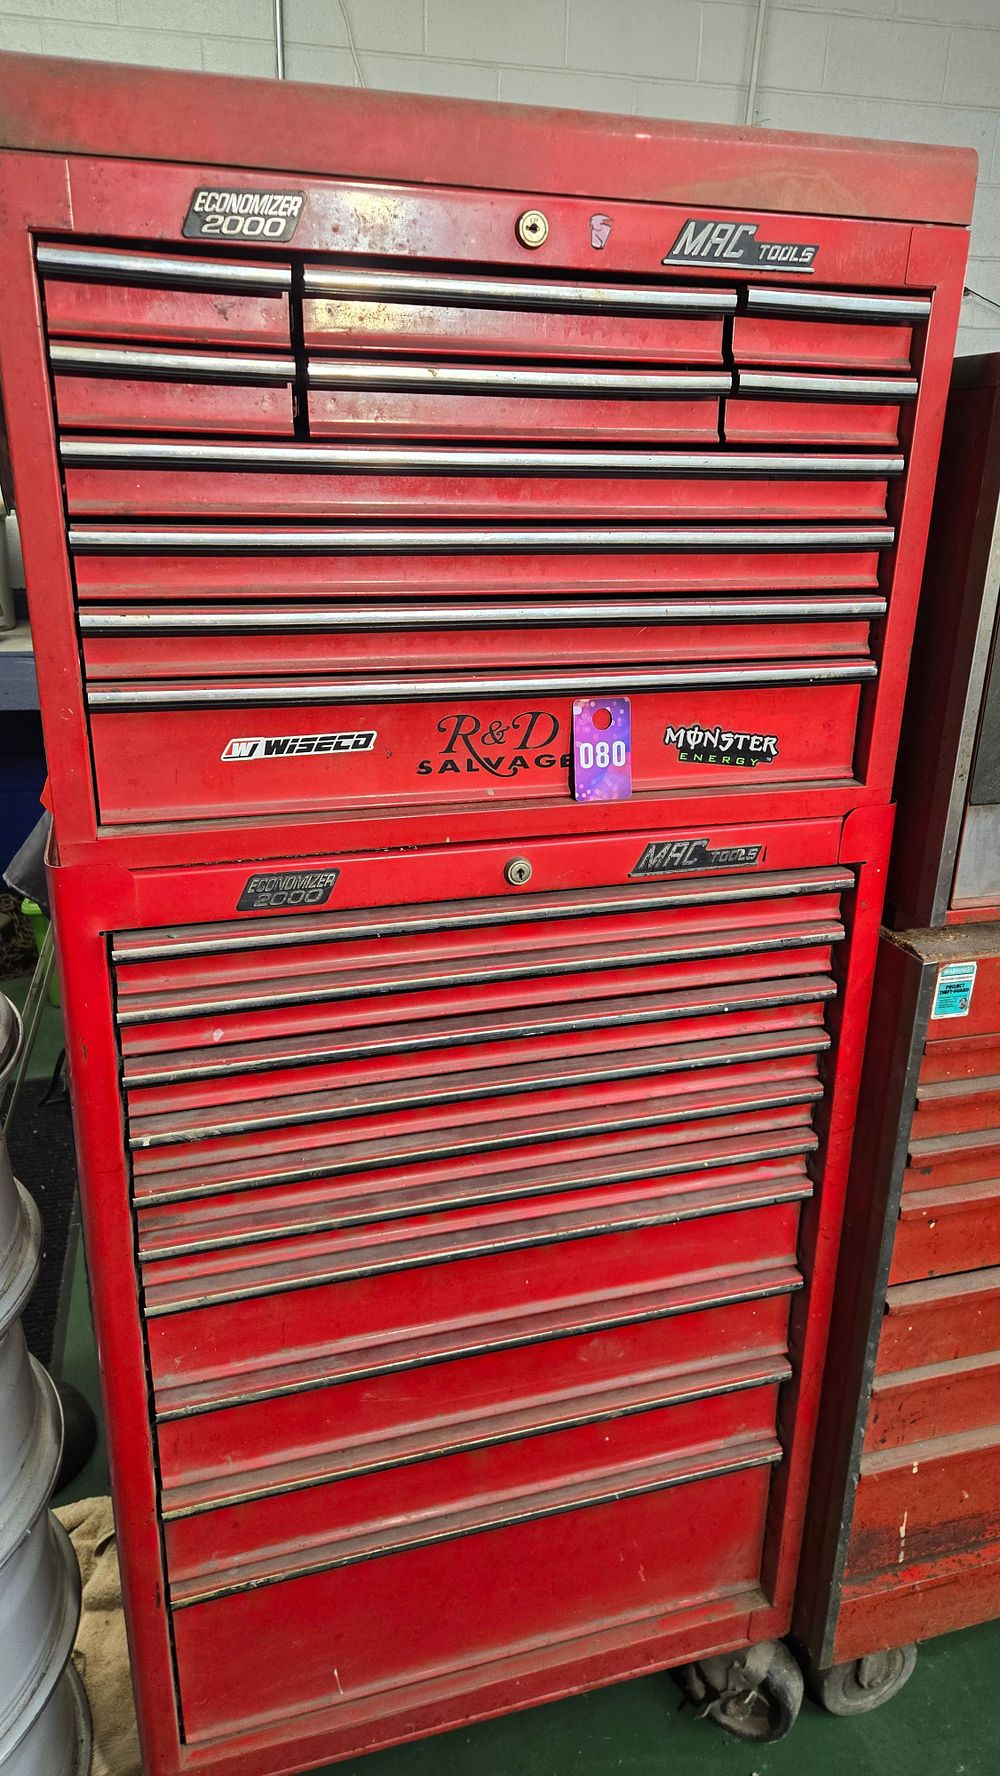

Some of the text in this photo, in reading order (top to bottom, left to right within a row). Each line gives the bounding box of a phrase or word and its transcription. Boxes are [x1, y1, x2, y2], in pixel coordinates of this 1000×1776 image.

[194, 191, 303, 217] ECONOMIZER
[201, 214, 287, 237] 2000
[672, 220, 815, 263] MAC TOOLS
[437, 711, 560, 778] R&D
[579, 740, 626, 769] 080
[679, 752, 758, 766] ENERGY
[640, 839, 757, 867] MAC TOOLS
[247, 873, 336, 894] ECONOMIZER
[253, 888, 324, 907] 2000
